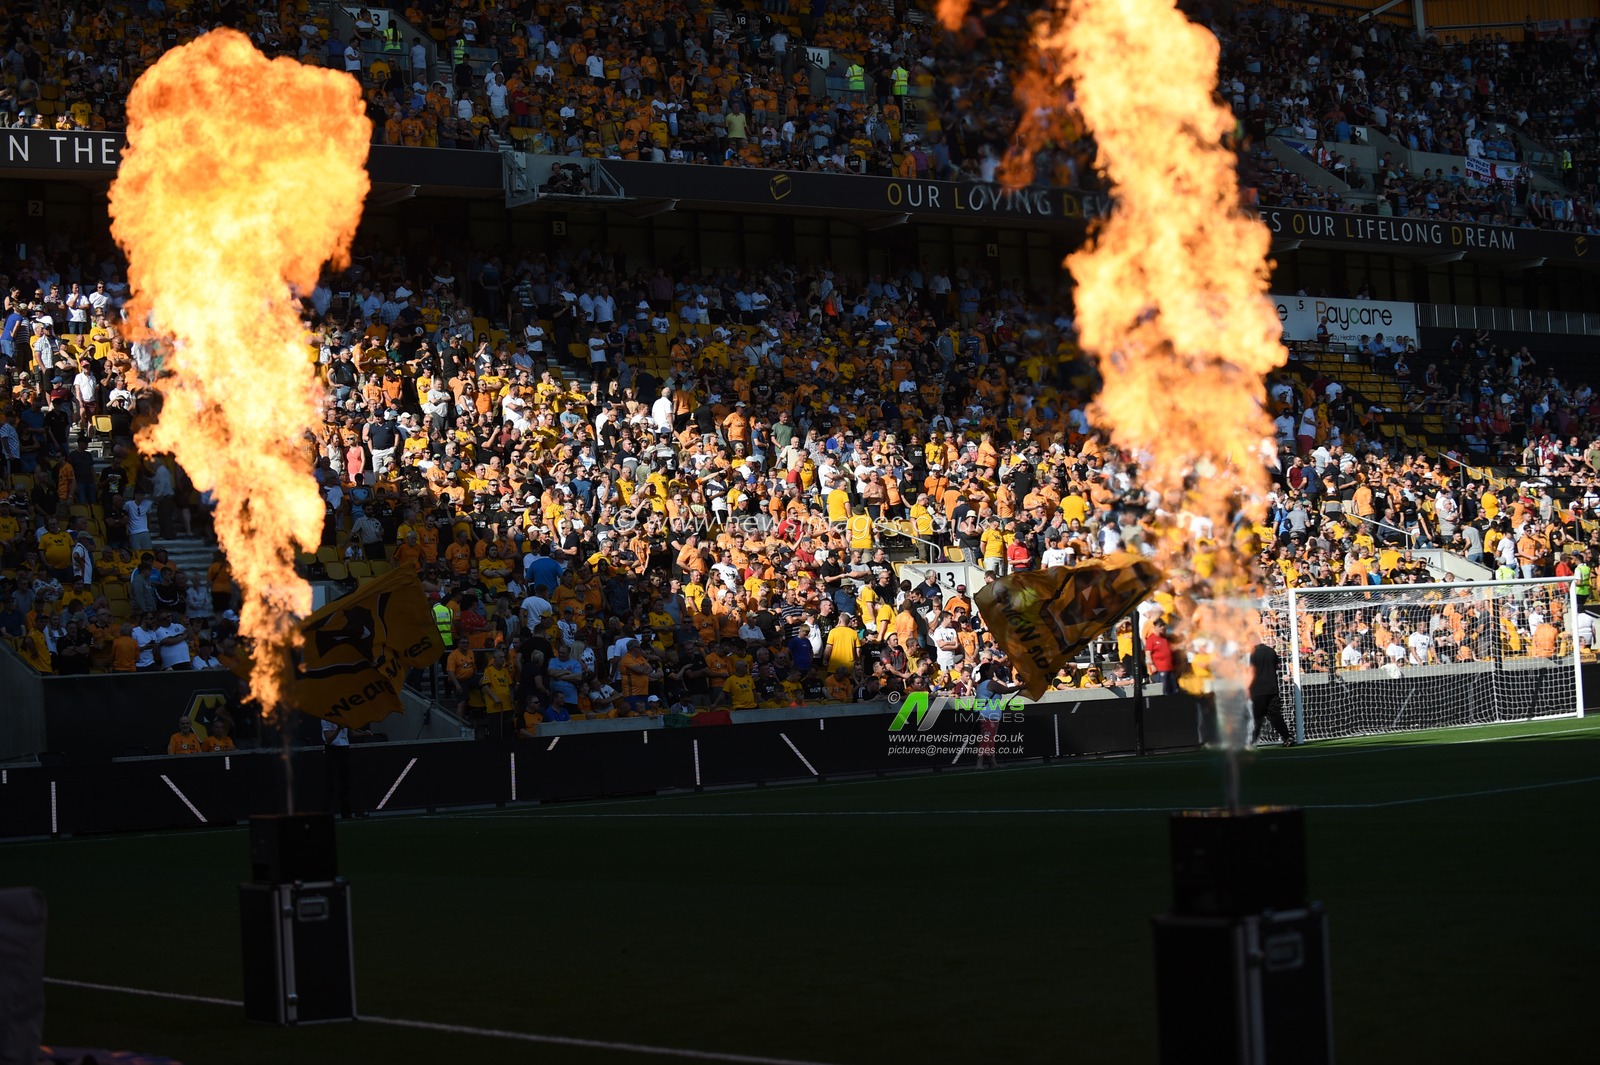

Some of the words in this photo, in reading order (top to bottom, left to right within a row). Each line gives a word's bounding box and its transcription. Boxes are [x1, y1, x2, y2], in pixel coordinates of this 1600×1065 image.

[736, 16, 747, 25] 18
[765, 15, 771, 23] 9
[48, 136, 117, 165] THE
[31, 202, 40, 214] 2
[886, 182, 941, 208] OUR
[954, 186, 1051, 216] LOVING
[1292, 213, 1336, 237] OUR
[1345, 216, 1443, 244] LIFELONG
[1452, 225, 1516, 250] DREAM
[555, 222, 563, 234] 3
[989, 245, 996, 256] 4
[1298, 300, 1305, 310] 5
[1315, 301, 1393, 331] Paycare
